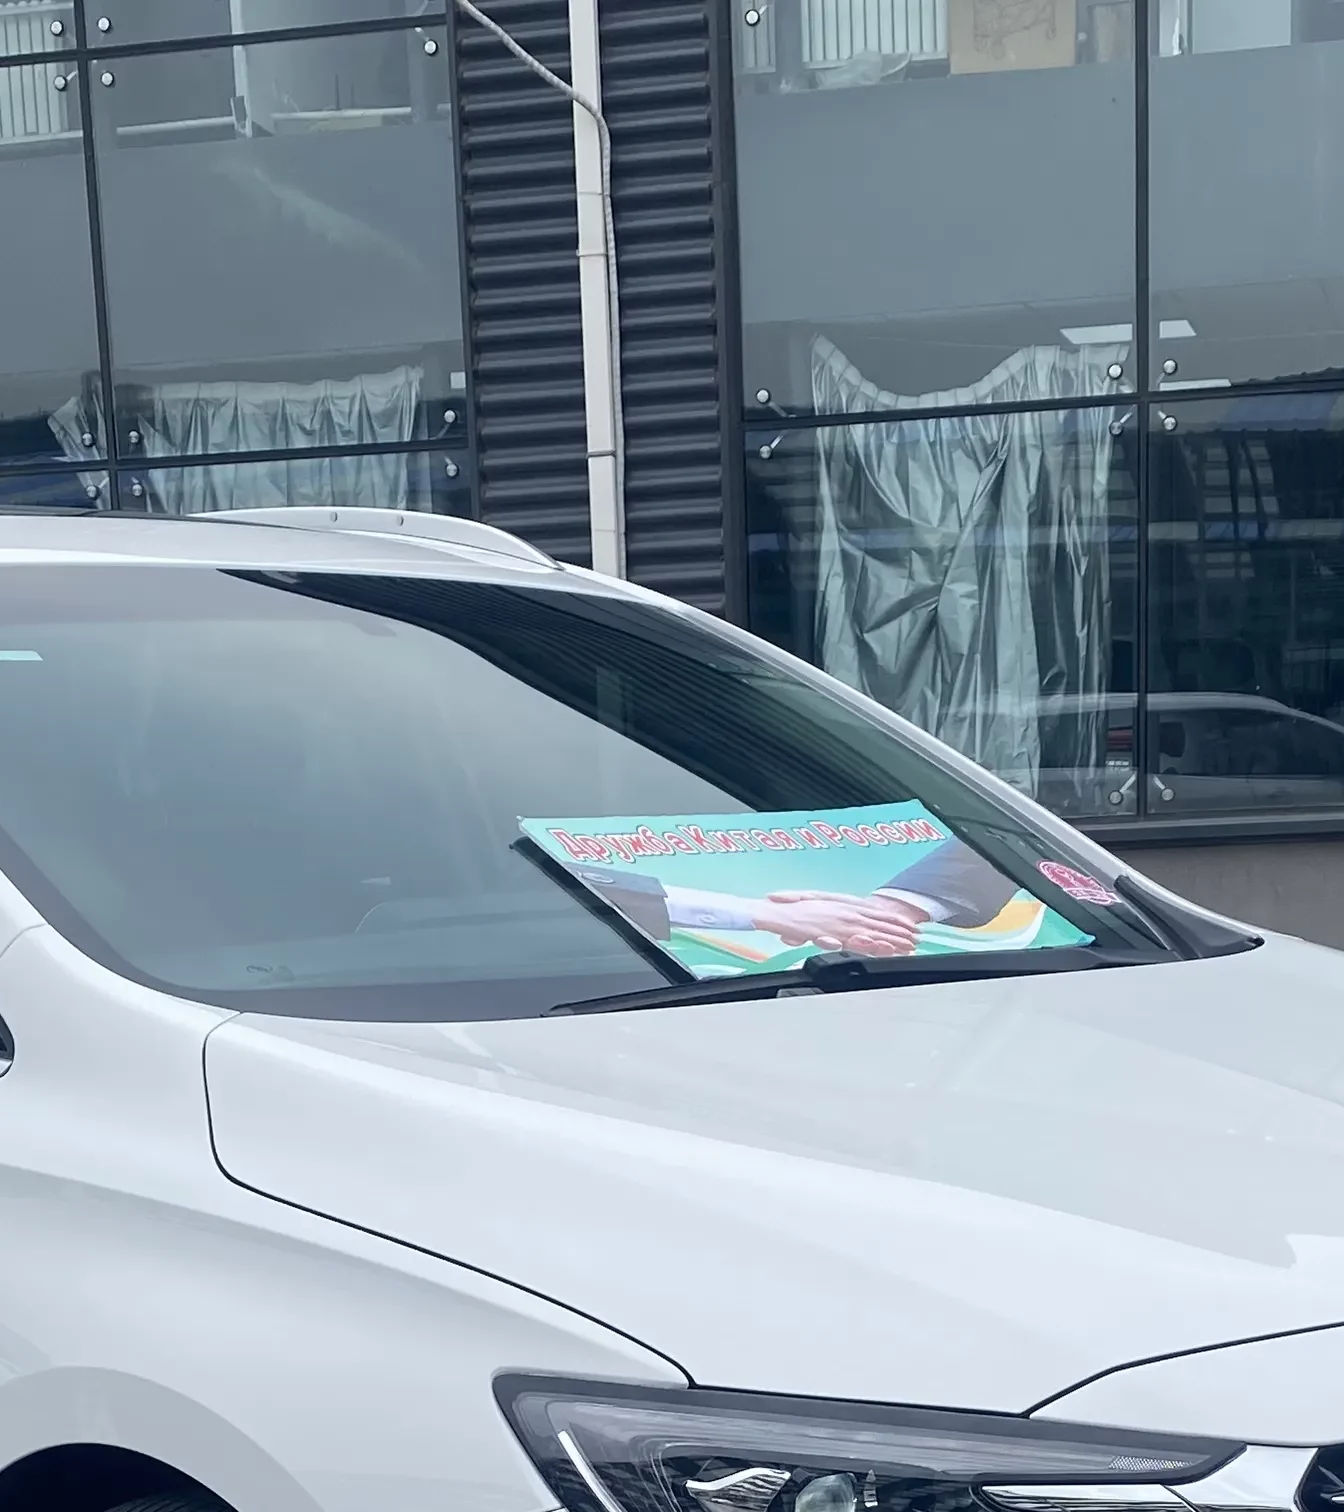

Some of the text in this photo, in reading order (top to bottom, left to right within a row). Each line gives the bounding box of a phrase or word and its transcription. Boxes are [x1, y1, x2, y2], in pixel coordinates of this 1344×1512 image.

[546, 825, 700, 864] Дружба
[676, 824, 804, 853] Китая
[808, 818, 947, 848] России
